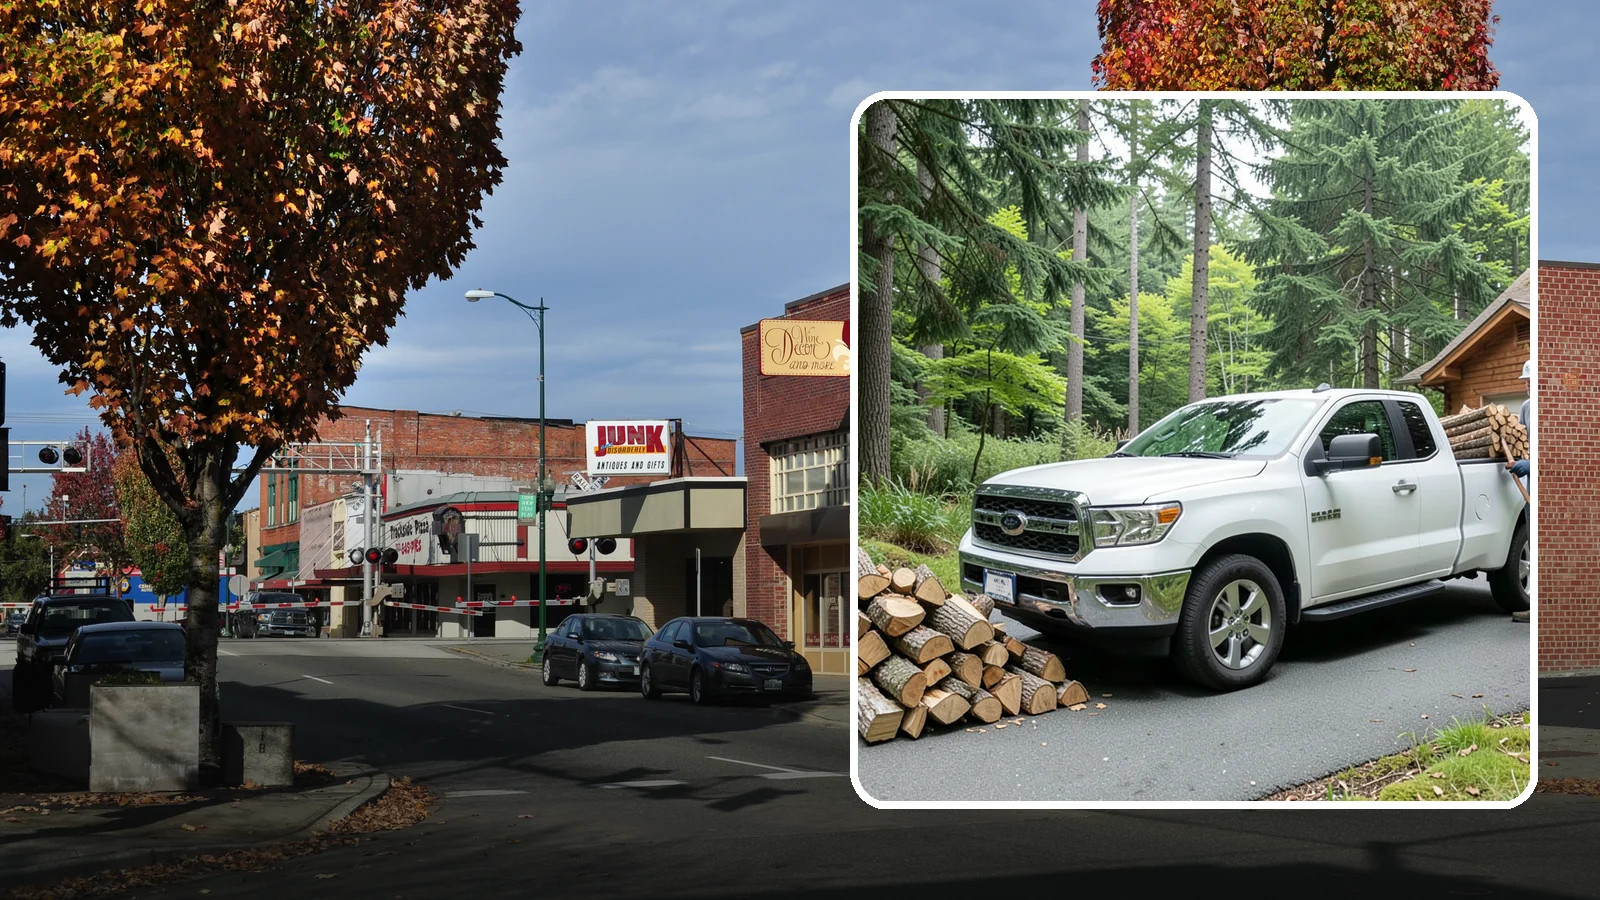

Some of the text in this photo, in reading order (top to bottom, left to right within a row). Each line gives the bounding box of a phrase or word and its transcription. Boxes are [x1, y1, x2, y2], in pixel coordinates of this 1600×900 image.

[595, 425, 665, 457] JUNK
[607, 446, 646, 454] DISORDERLY
[596, 460, 665, 470] ANTIQUES AND GIFTS
[390, 519, 429, 540] Trackside Pizza
